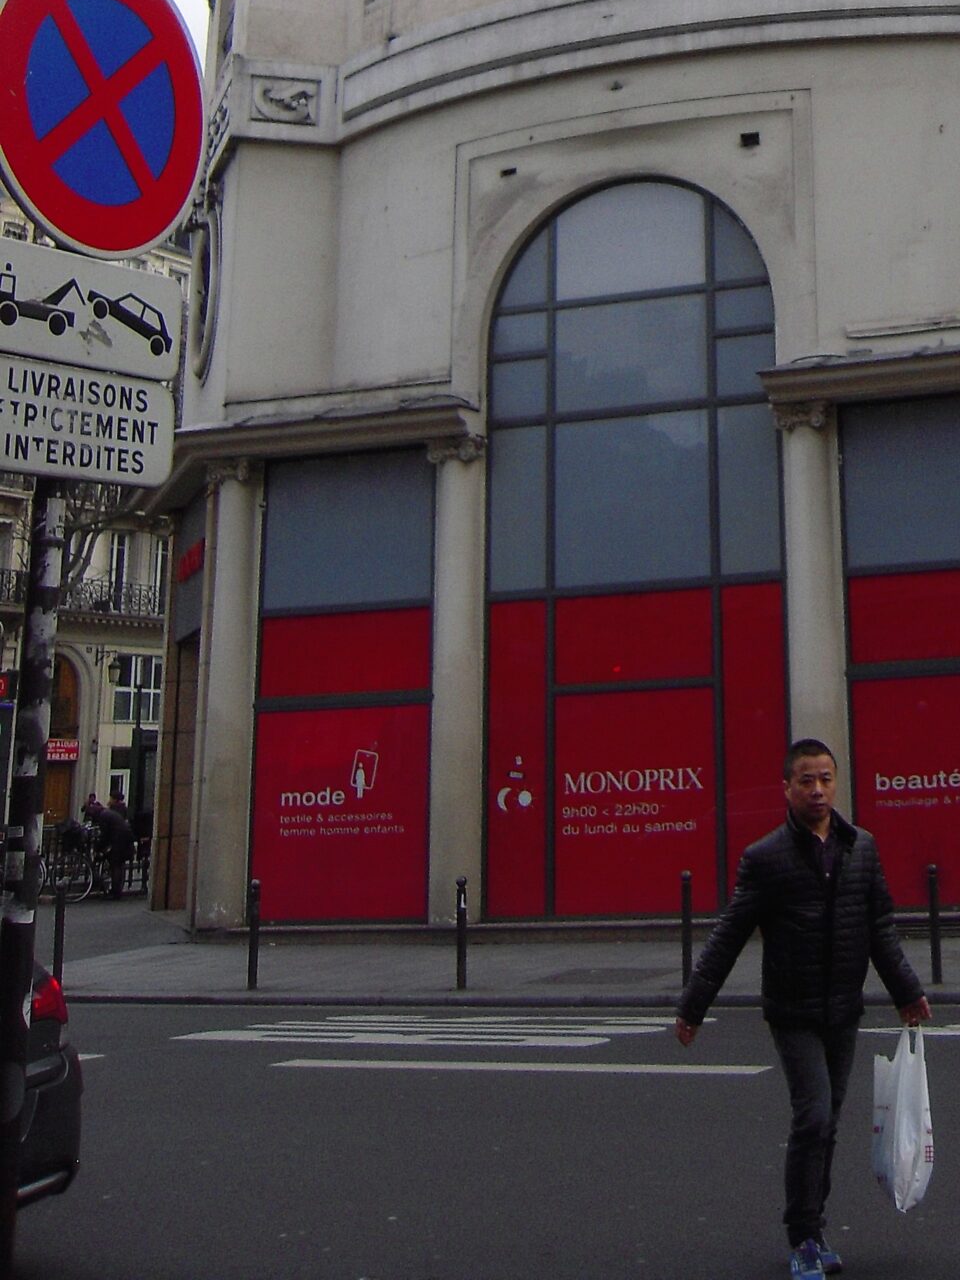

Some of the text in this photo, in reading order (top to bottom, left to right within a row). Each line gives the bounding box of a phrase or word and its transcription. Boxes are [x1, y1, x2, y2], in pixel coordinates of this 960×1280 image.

[8, 367, 149, 413] LIVRAISONS
[4, 433, 145, 475] INTERDITES
[563, 767, 704, 796] MONOPRIX
[280, 786, 346, 807] mode
[280, 814, 313, 825] textile
[327, 810, 394, 823] accessoires
[562, 805, 598, 819] 9h00
[614, 802, 660, 817] 22h00
[280, 823, 405, 837] femme homme enfants
[562, 819, 697, 836] du lundi au samedi
